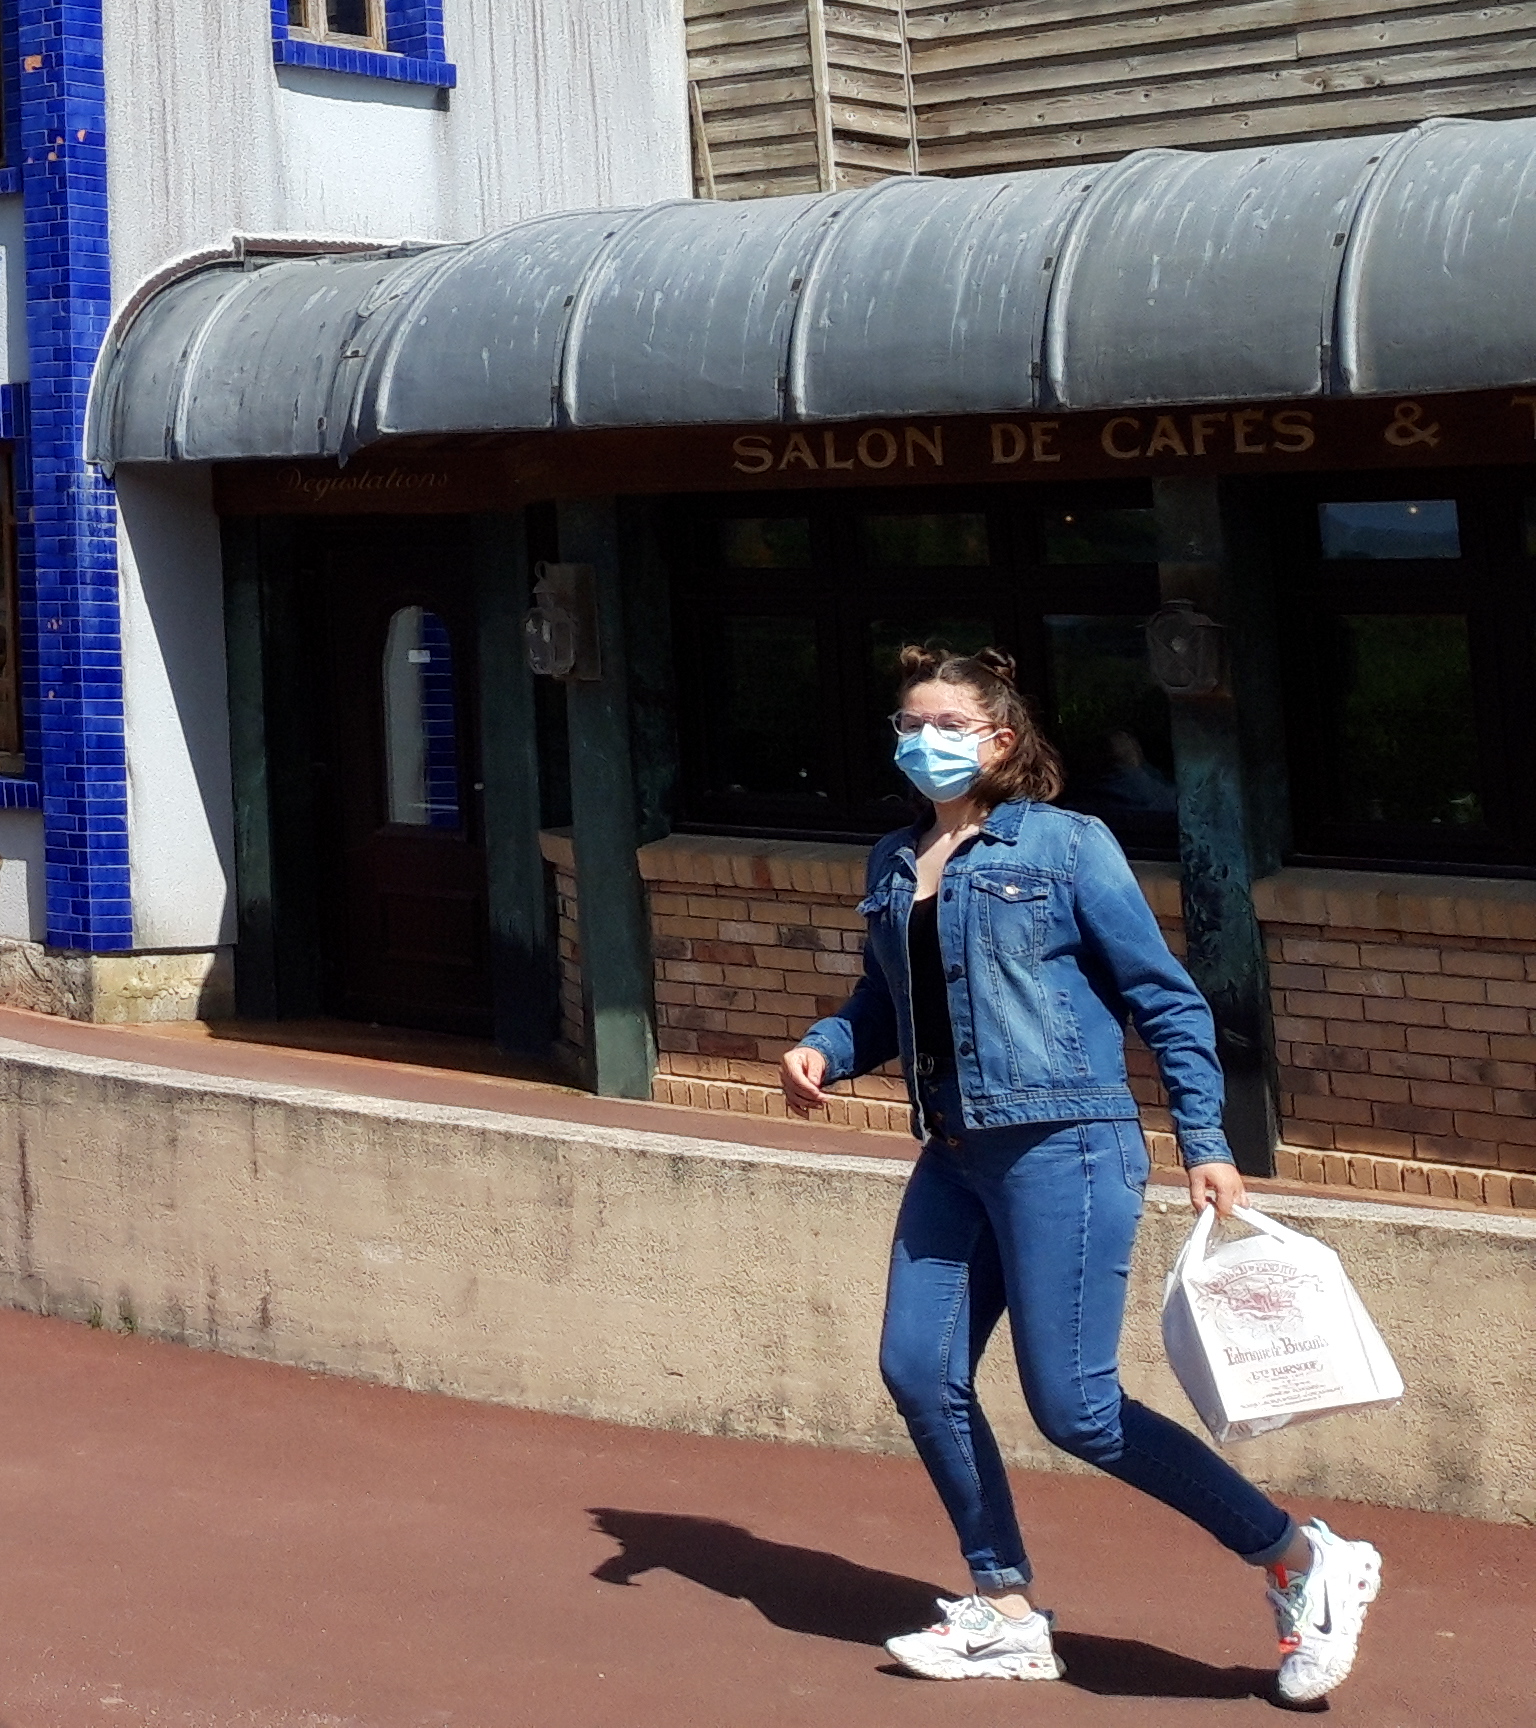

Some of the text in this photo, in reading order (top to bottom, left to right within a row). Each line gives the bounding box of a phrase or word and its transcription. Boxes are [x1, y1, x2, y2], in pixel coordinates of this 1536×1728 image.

[732, 425, 944, 473] SALON
[991, 421, 1061, 465] DE
[1384, 400, 1441, 448] &
